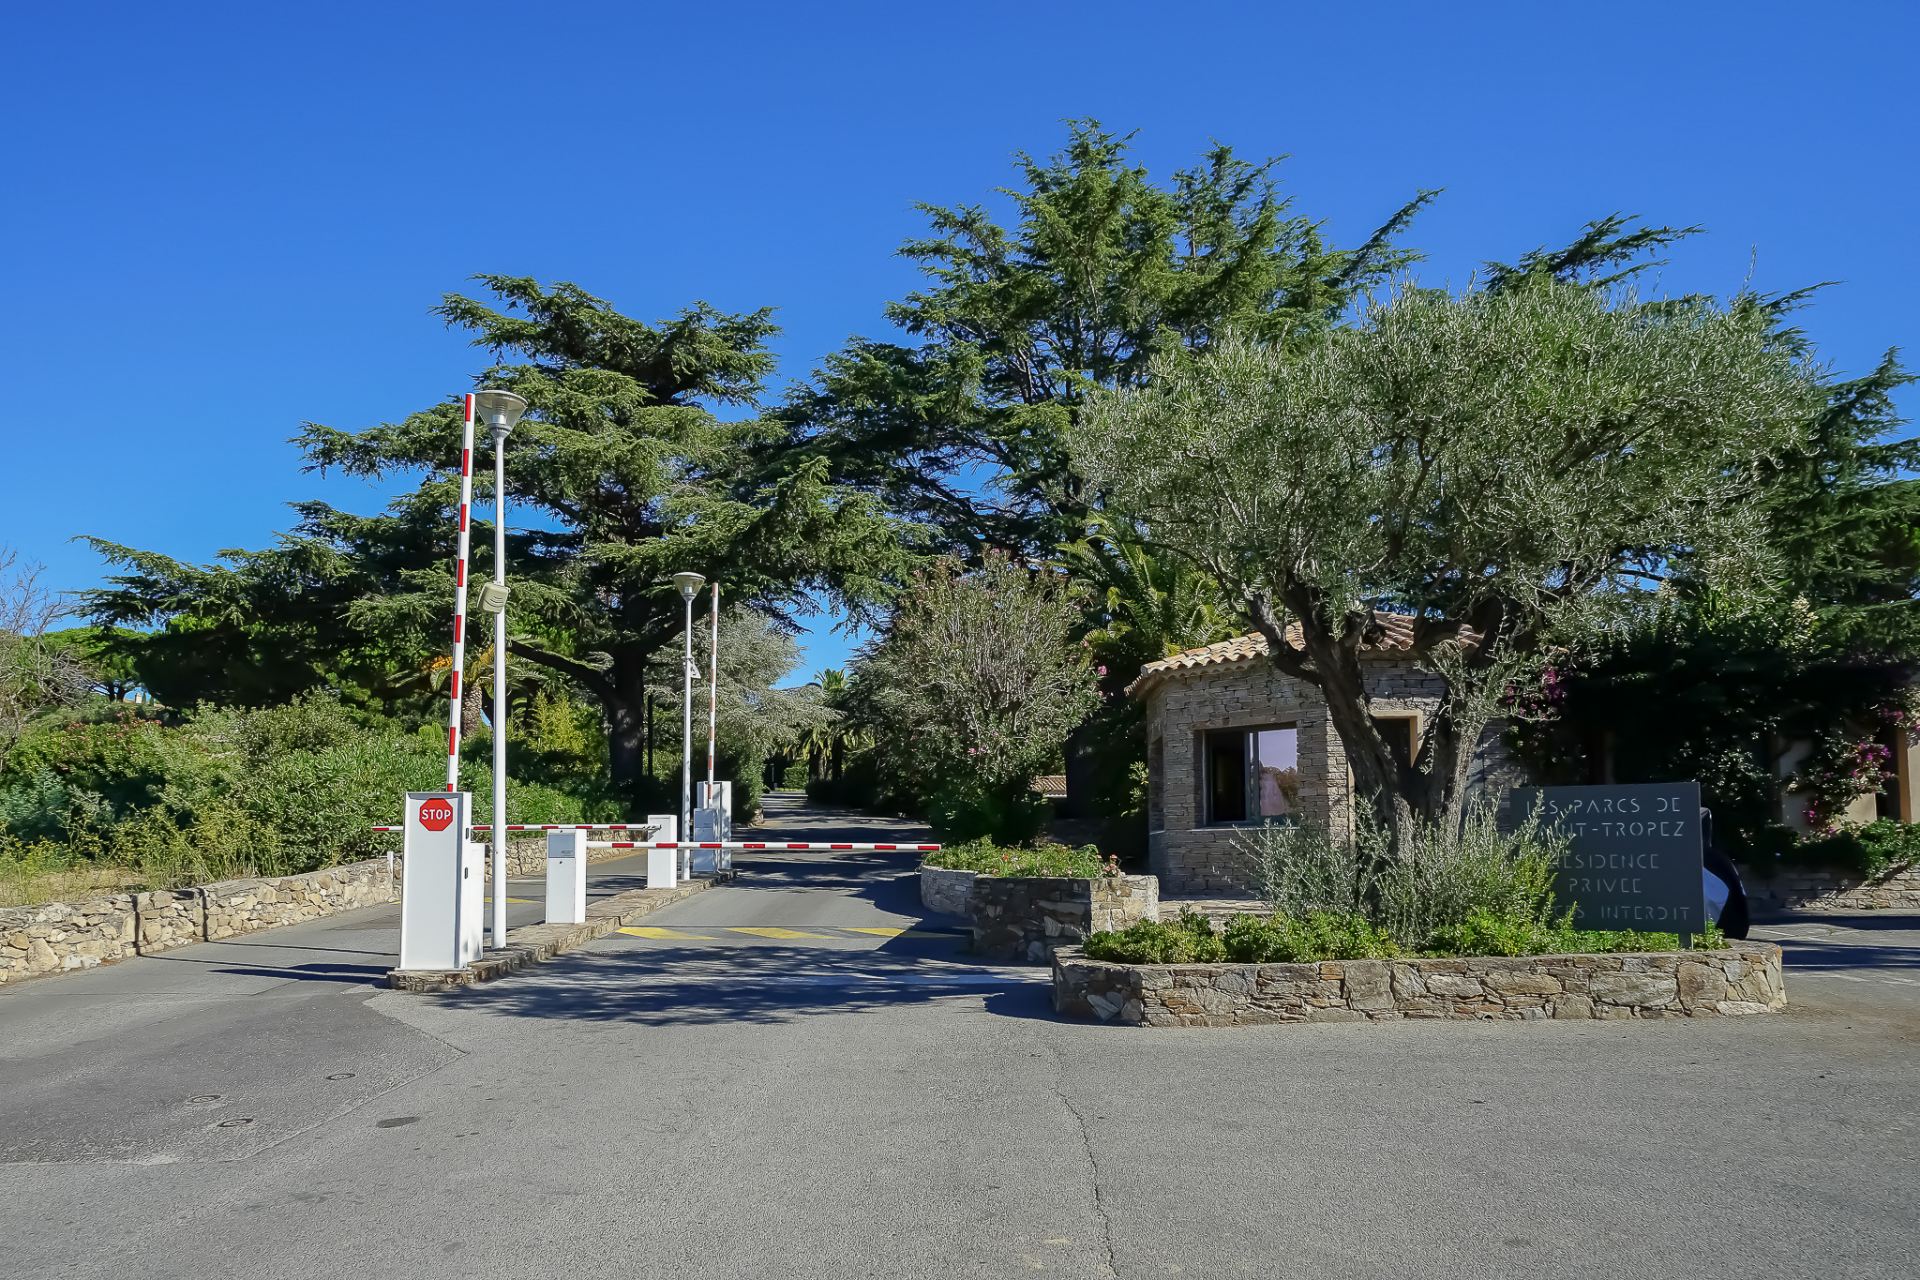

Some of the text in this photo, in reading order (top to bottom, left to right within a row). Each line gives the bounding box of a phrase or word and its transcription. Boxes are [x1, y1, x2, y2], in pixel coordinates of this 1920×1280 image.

[1573, 798, 1640, 814] PARCS
[1657, 797, 1681, 812] DE
[421, 809, 451, 820] STOP
[1537, 821, 1684, 841] AINT-TROPEZ
[1569, 878, 1642, 894] PRIVEE
[1601, 905, 1690, 921] INTERDIT
